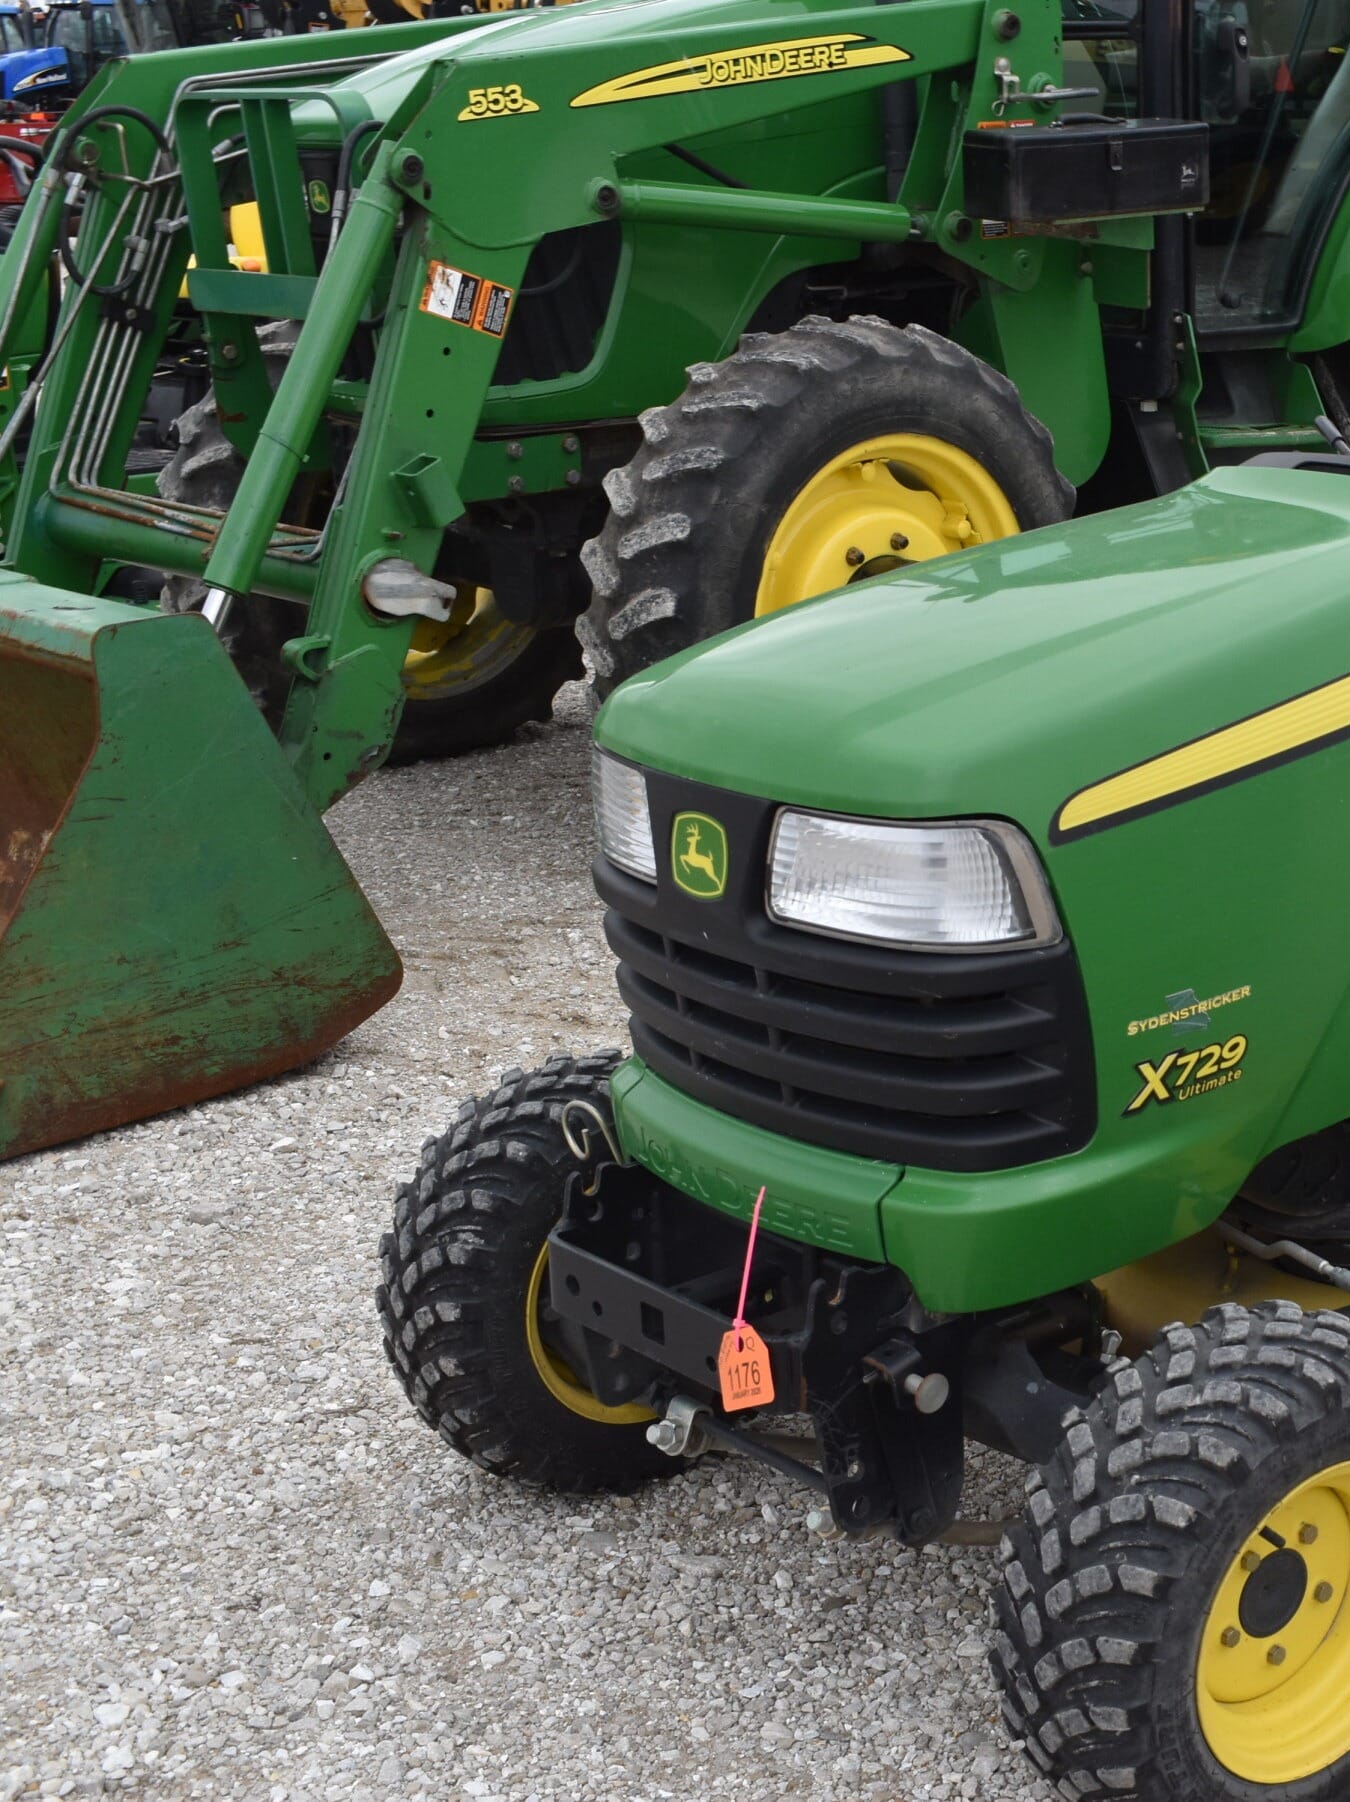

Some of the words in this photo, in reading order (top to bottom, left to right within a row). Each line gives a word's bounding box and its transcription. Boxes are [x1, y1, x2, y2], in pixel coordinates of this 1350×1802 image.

[700, 57, 764, 84] JOHN
[765, 43, 848, 75] DEERE
[468, 84, 524, 116] 553
[1127, 985, 1252, 1036] SYDENSTRICKER
[1126, 1035, 1248, 1112] X729
[1178, 1069, 1243, 1101] Ultimate
[728, 1360, 761, 1391] 1176
